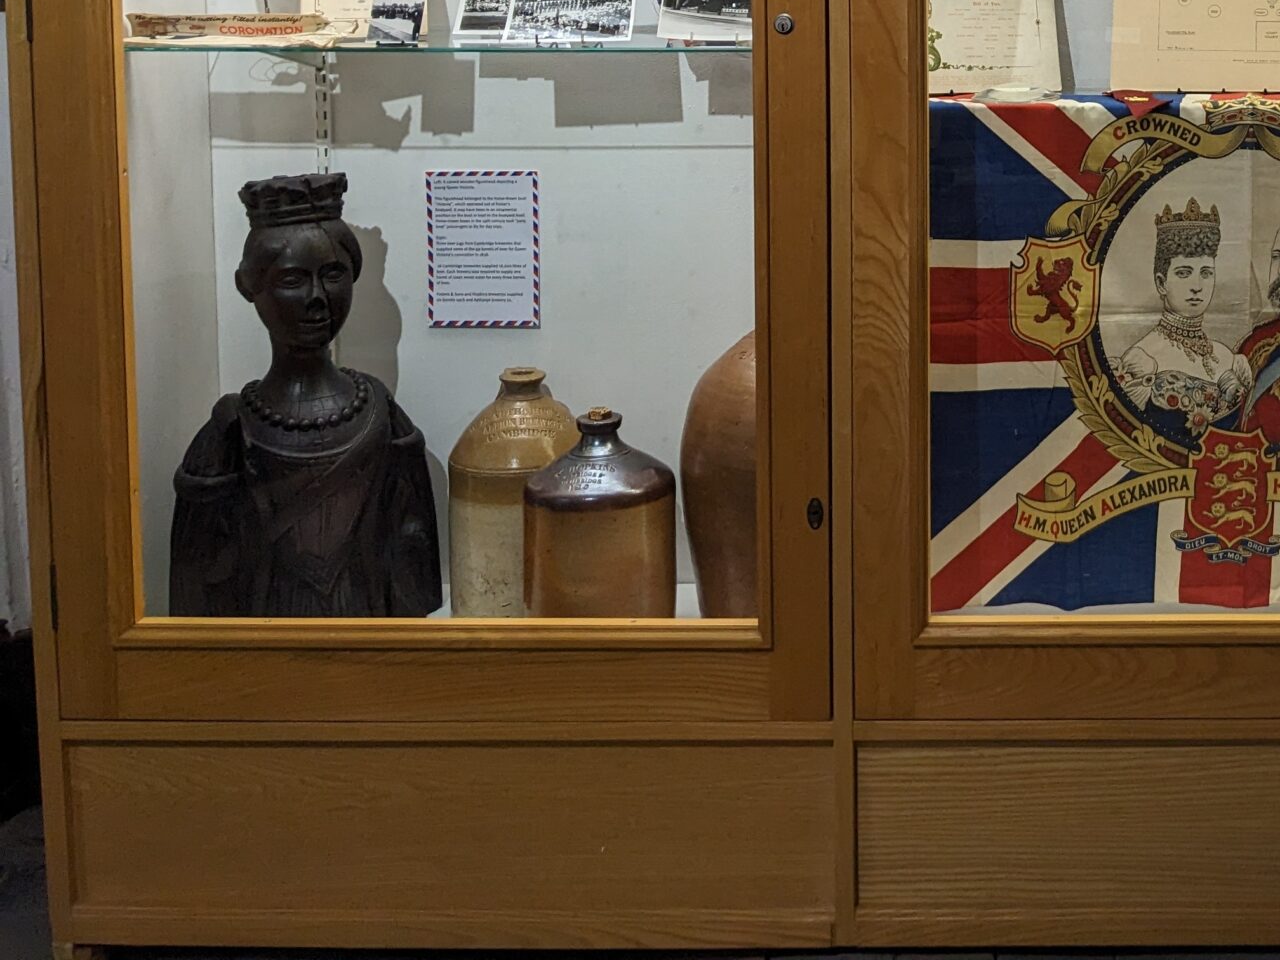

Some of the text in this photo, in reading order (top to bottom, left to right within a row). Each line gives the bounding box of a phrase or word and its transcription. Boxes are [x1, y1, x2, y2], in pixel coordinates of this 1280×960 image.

[219, 25, 303, 35] CORONATION
[1112, 118, 1201, 147] CROWNED
[568, 463, 617, 473] HOPKINS
[1018, 474, 1190, 539] H.M. QUEEN ALEXANDRA
[1185, 538, 1206, 549] DIEU
[1247, 541, 1270, 554] DROIT
